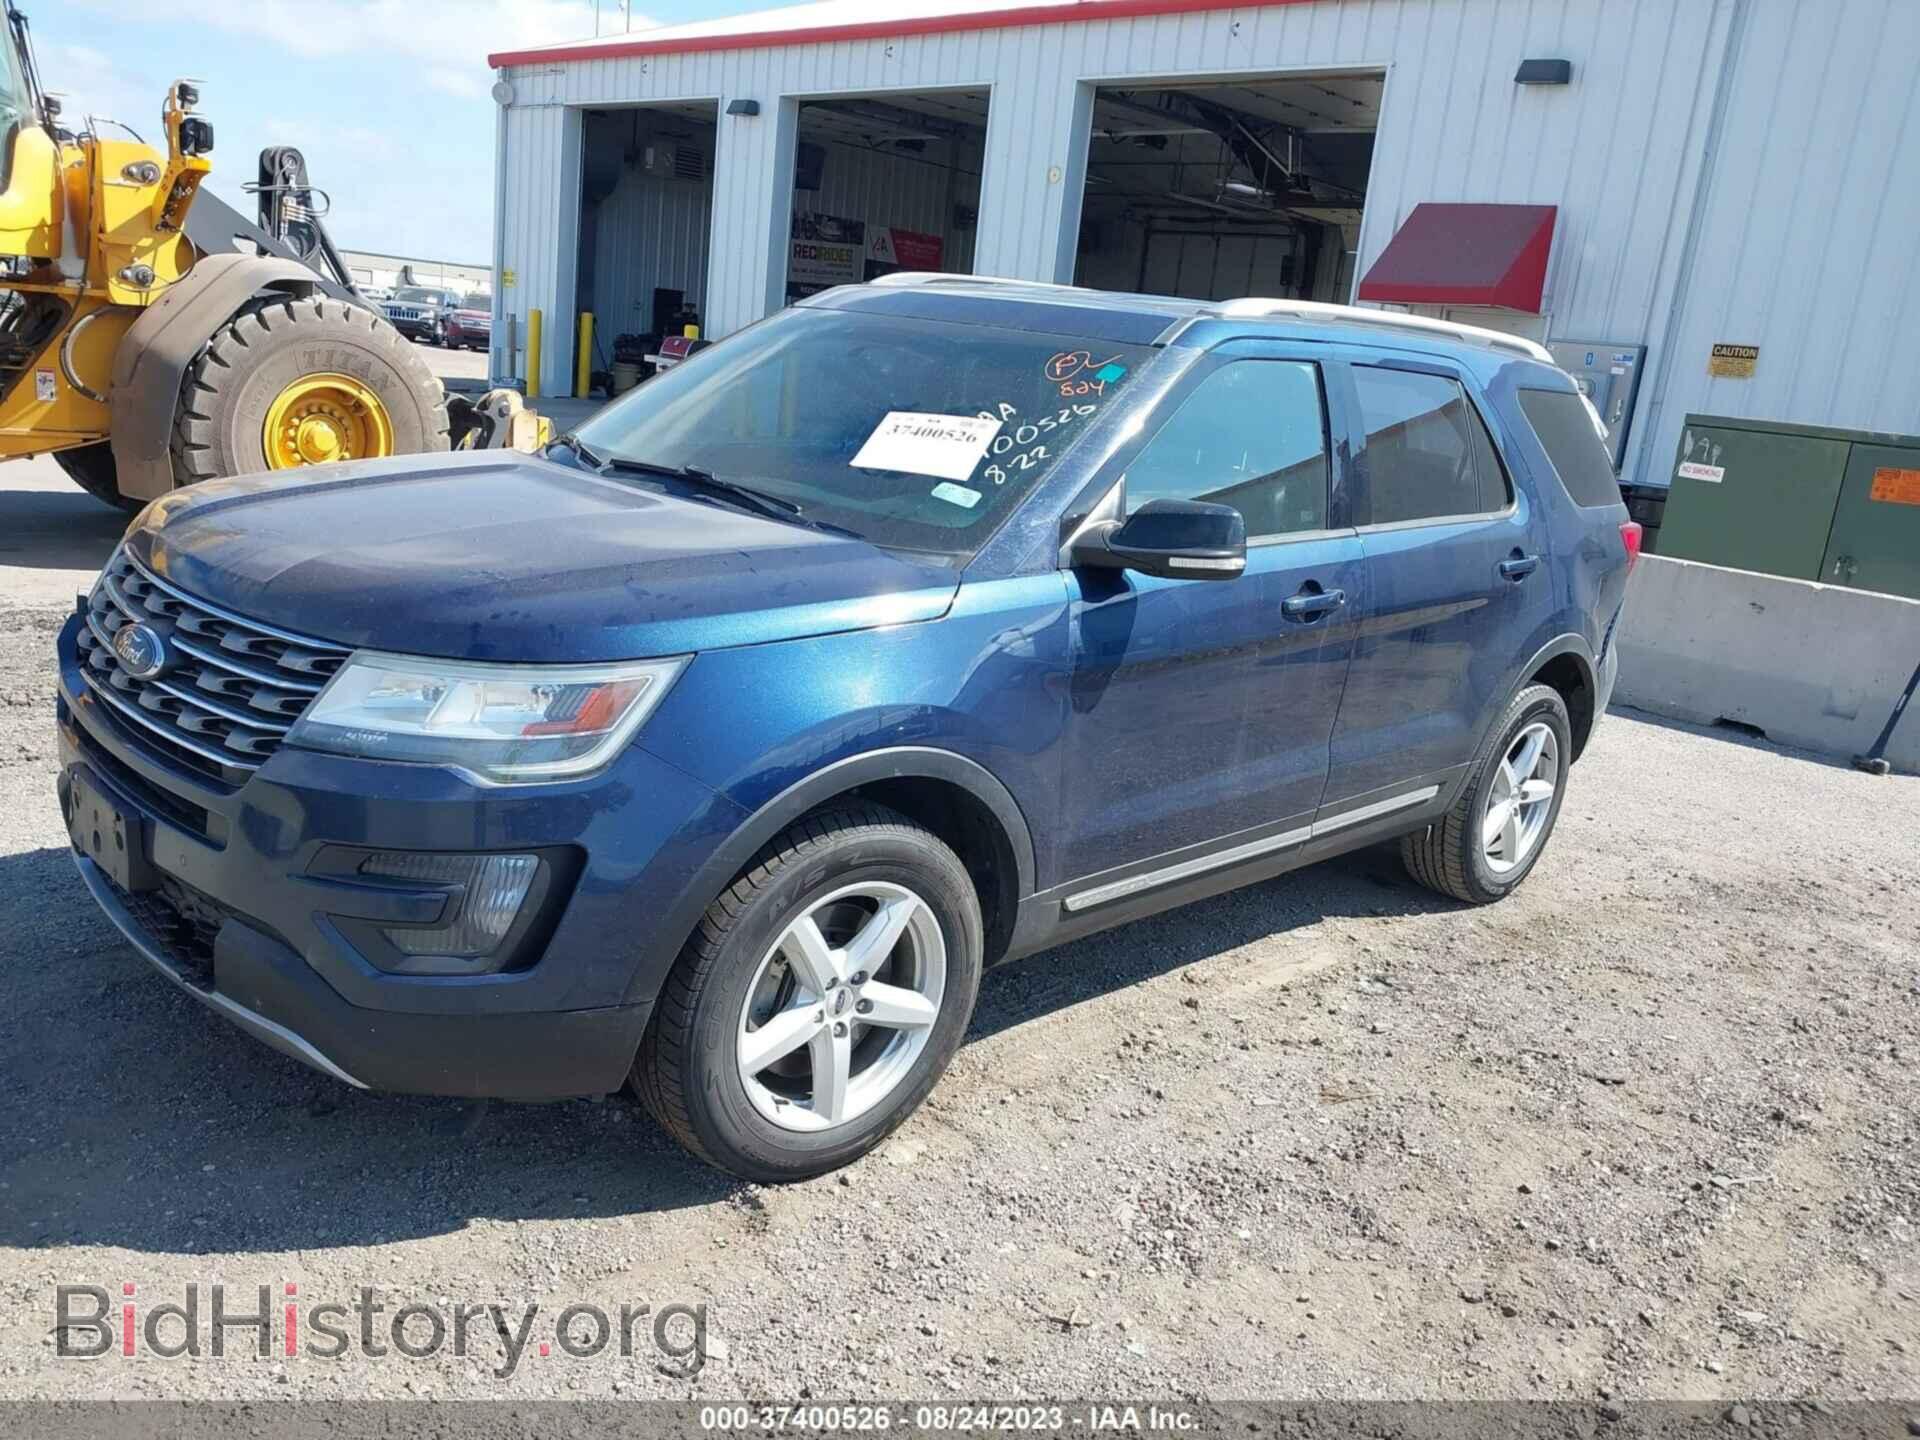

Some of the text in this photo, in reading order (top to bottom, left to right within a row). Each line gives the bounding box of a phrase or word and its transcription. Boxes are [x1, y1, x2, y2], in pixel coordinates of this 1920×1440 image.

[1714, 346, 1756, 358] CAUTION
[886, 424, 977, 443] 37400526
[116, 630, 145, 665] Ford
